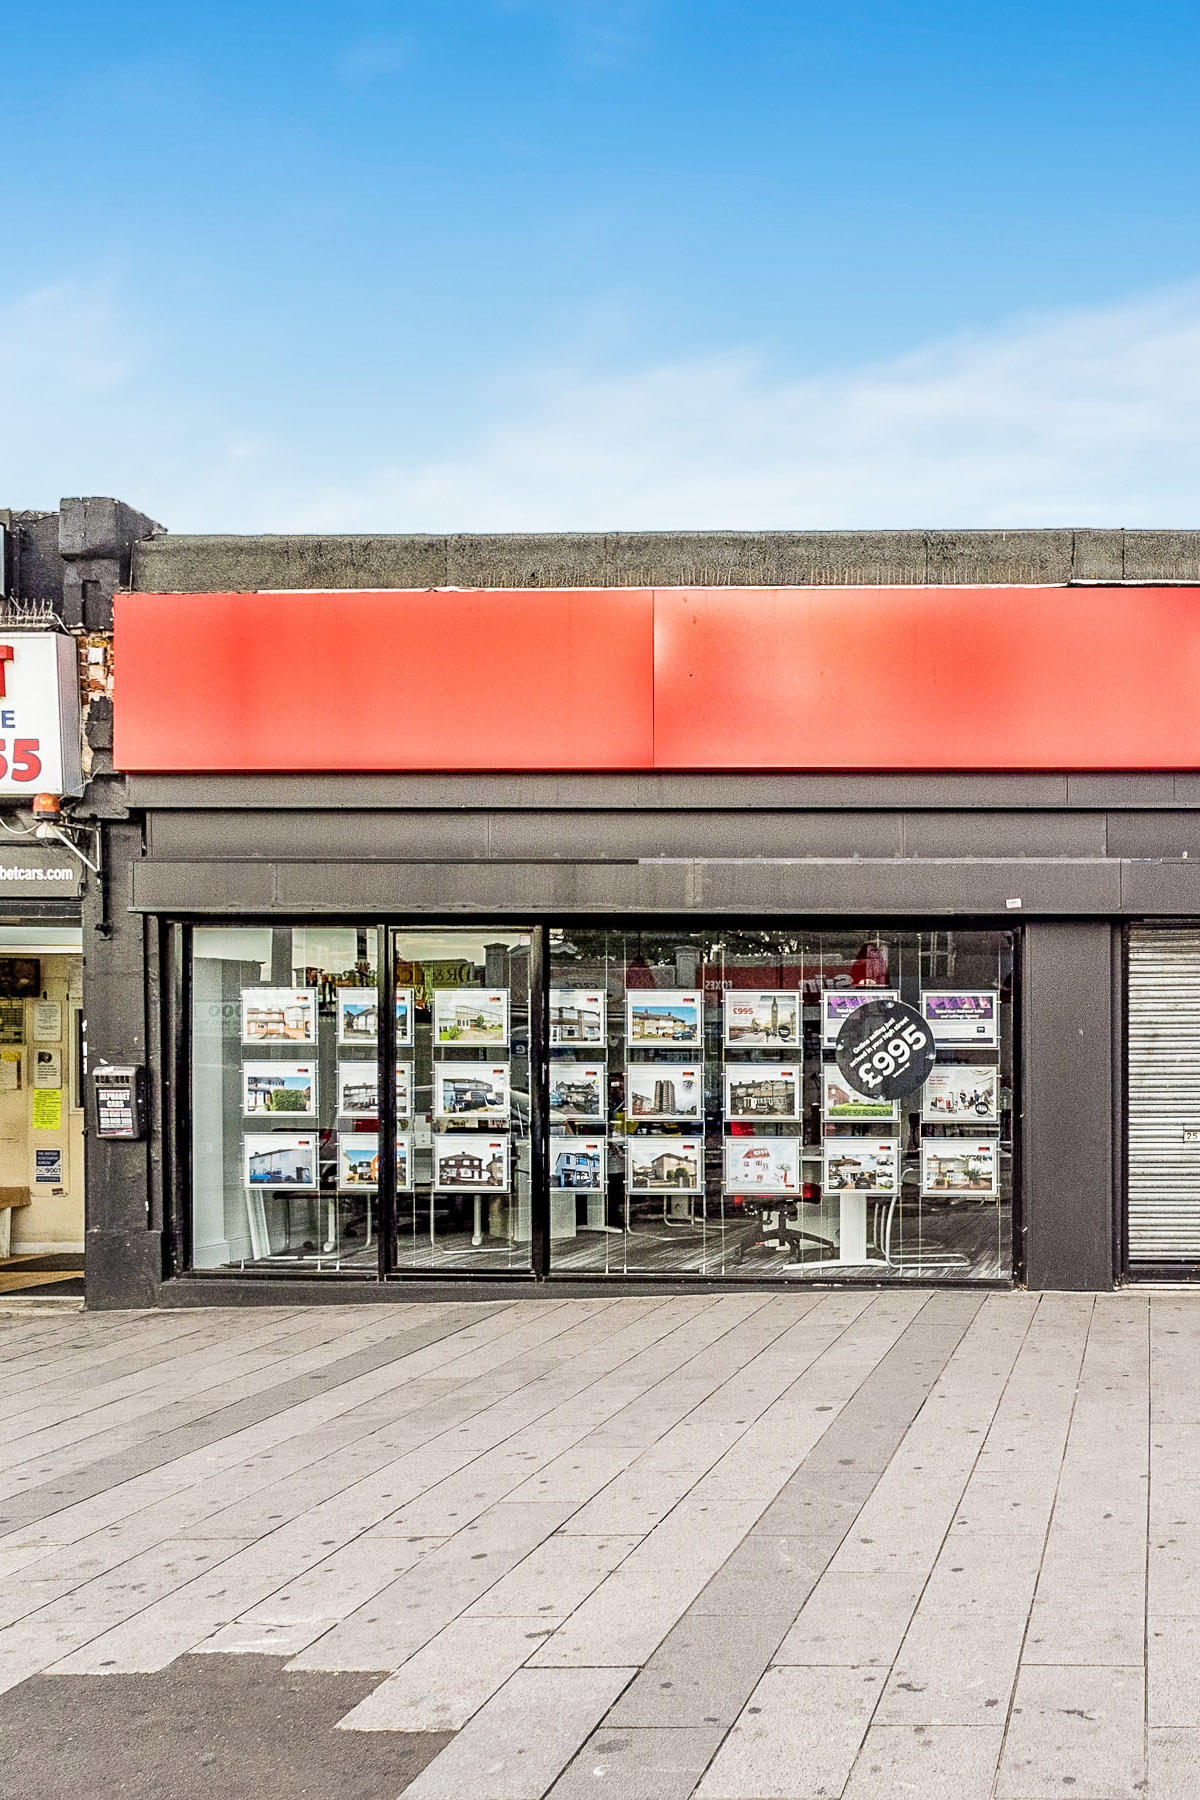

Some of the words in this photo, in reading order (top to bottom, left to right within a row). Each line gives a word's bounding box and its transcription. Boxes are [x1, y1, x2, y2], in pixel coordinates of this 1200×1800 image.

[0, 738, 42, 782] 5
[858, 1023, 927, 1088] £995
[1186, 1132, 1198, 1140] 25
